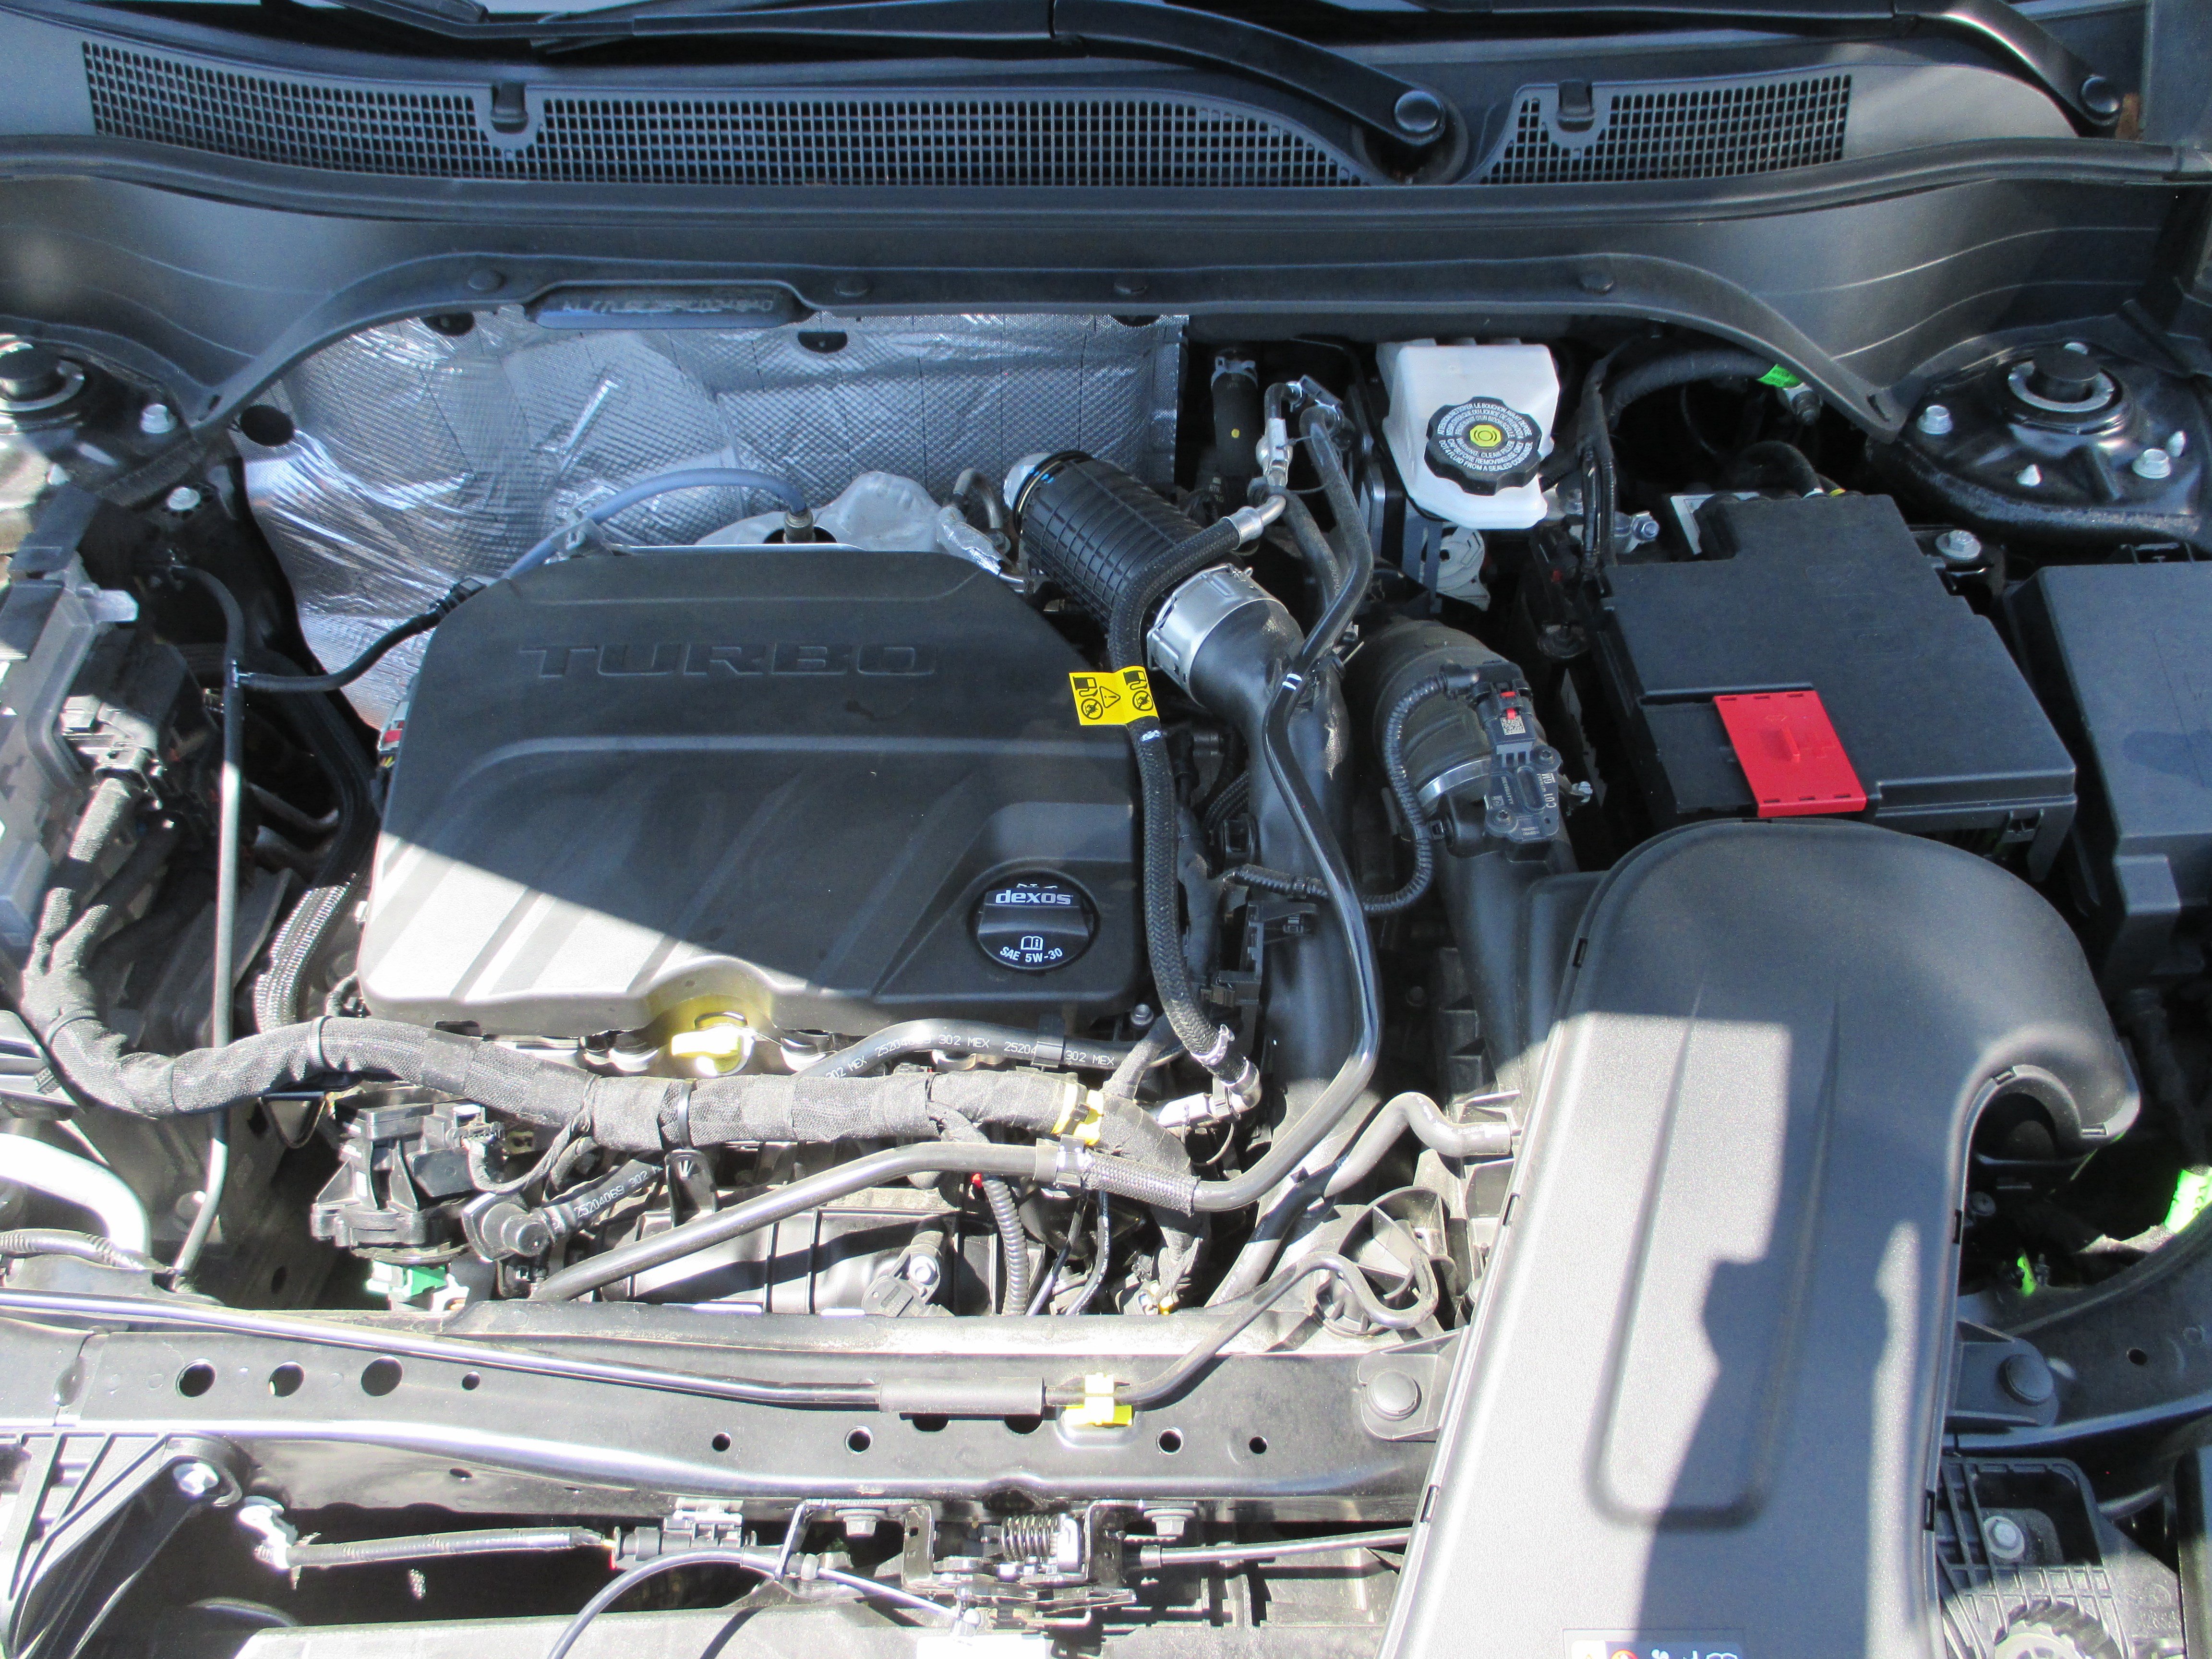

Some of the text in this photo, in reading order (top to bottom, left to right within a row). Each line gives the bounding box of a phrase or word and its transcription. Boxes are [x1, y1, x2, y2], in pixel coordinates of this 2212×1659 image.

[1481, 402, 1508, 413] BOUCHON
[1446, 451, 1465, 464] FLUID
[1462, 460, 1482, 470] FROM
[1488, 461, 1513, 472] SEALED
[1480, 450, 1503, 458] CLEAN
[517, 642, 938, 679] TURBO
[995, 890, 1071, 905] dexos
[999, 946, 1063, 963] SAE 5W-30
[847, 1055, 868, 1072] MEX
[938, 1034, 961, 1046] 302
[967, 1036, 990, 1049] MEX
[1065, 1049, 1086, 1063] 302
[1092, 1055, 1115, 1066] MEX
[628, 1170, 648, 1188] 302
